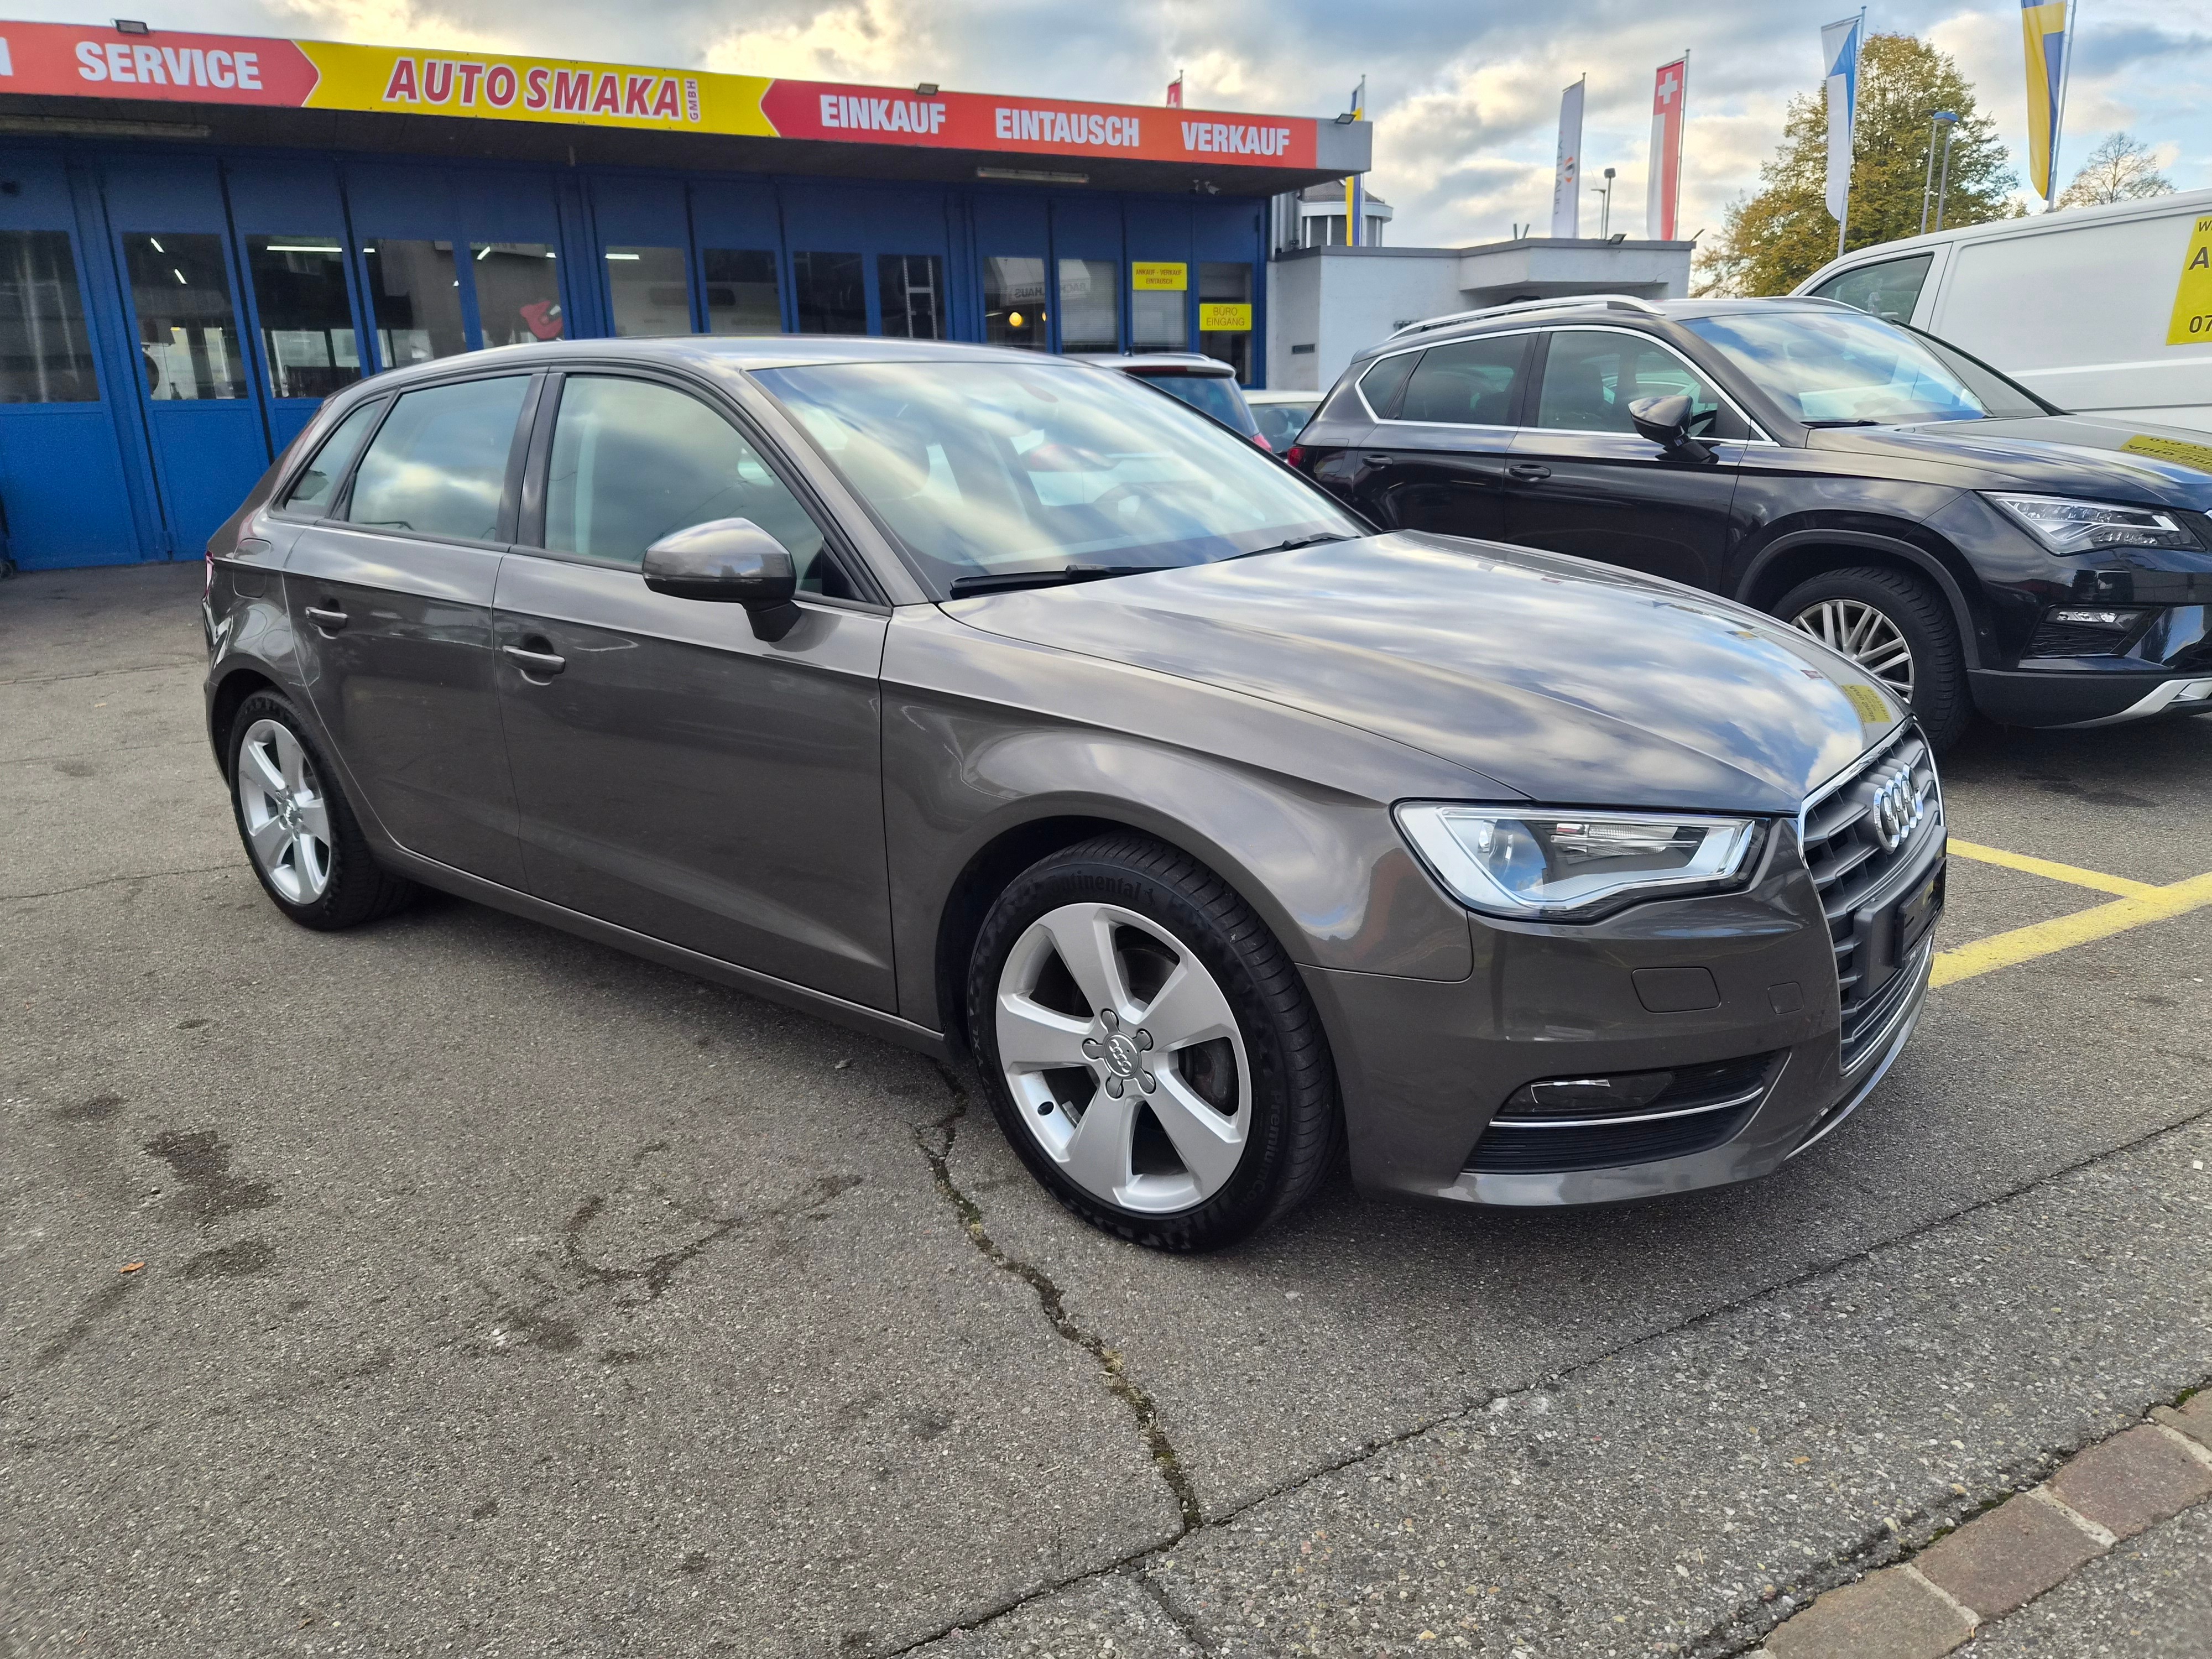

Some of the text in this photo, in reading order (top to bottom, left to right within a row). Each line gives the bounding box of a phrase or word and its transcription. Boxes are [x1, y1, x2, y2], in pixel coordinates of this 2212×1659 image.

[75, 41, 263, 90] SERVICE
[383, 58, 680, 121] AUTO SMAKA
[686, 79, 700, 122] GMBH
[820, 95, 946, 134] EINKAUF
[995, 108, 1140, 148] EINTAUSCH
[1181, 122, 1290, 156] VERKAUF
[1206, 317, 1245, 326] EINGANG
[1213, 305, 1238, 316] BÜRO
